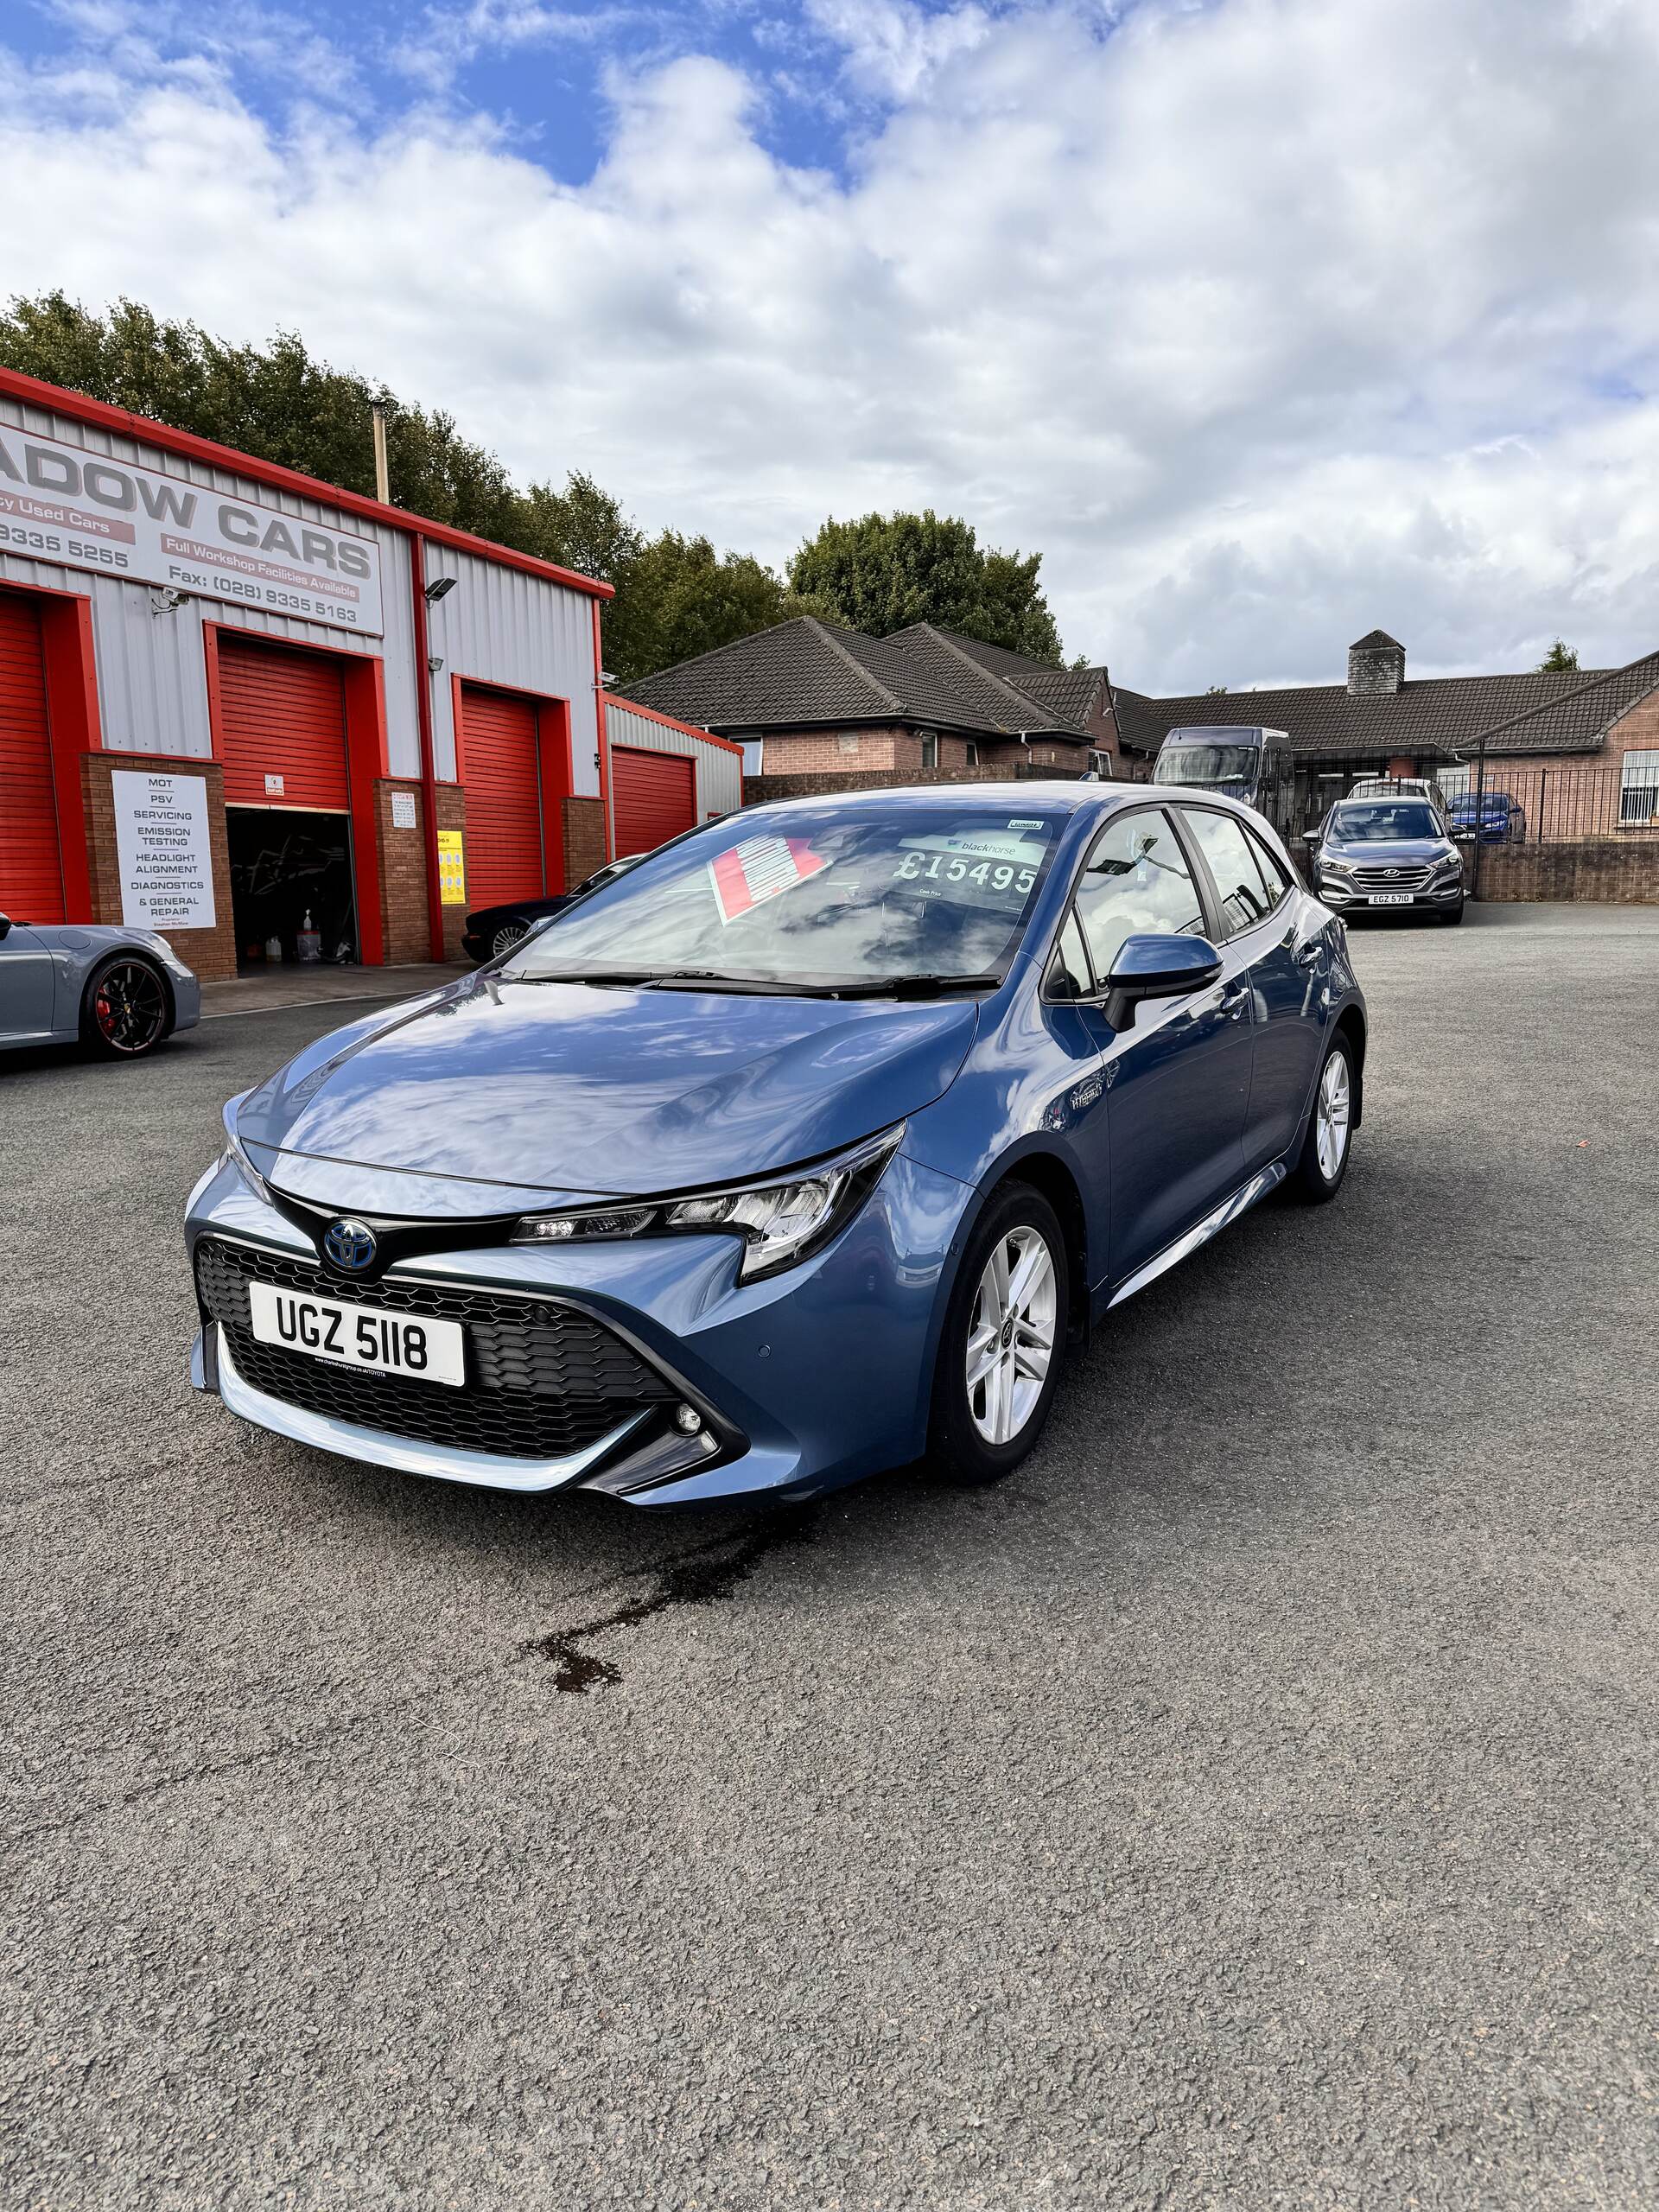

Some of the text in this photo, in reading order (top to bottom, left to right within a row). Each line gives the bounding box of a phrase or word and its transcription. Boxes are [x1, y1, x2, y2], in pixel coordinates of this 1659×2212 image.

[19, 499, 64, 521] Used
[69, 512, 111, 533] Cars
[0, 524, 129, 568] 9335 5255
[218, 505, 372, 580] CARS
[166, 538, 357, 598] Full Workshop Facilities Available
[168, 565, 357, 623] Fax: (028) 9335 5163
[148, 779, 173, 788] MOT
[150, 795, 173, 804] PSV
[133, 810, 192, 821] SERVICING
[137, 827, 191, 836] EMISSION
[142, 837, 188, 846] TESTING
[961, 842, 1016, 856] blackhorse
[136, 854, 196, 862] HEADLIGHT
[893, 852, 1038, 894] £15495
[130, 881, 204, 890] DIAGNOSTICS
[139, 897, 199, 906] & GENERAL
[1391, 894, 1409, 903] 5710
[150, 907, 189, 916] REPAIR
[276, 1297, 428, 1370] UGZ 5118
